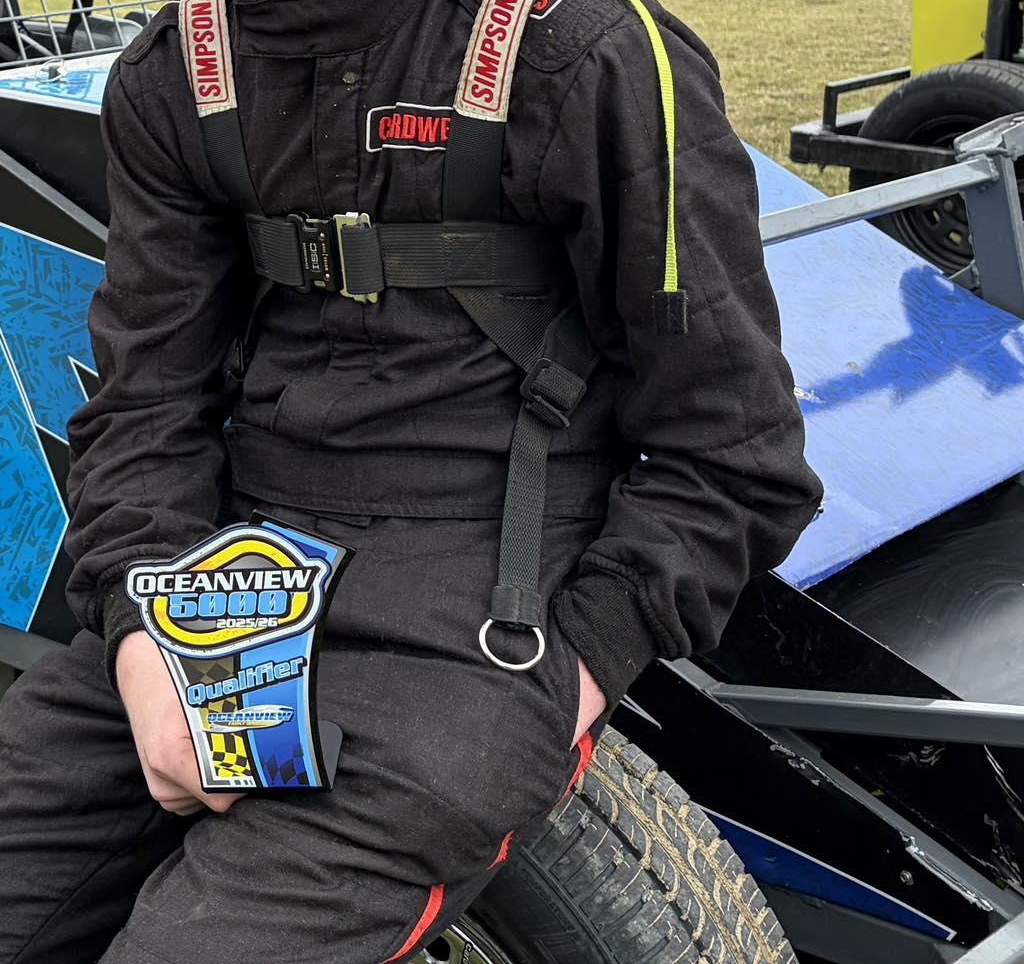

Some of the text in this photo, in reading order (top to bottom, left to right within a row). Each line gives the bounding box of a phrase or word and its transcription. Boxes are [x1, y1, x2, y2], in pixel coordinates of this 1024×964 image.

[191, 1, 222, 99] SIMPSON
[136, 569, 312, 594] OCEANVIEW
[168, 590, 288, 619] 5000
[216, 618, 279, 629] 2025/26
[187, 657, 304, 705] Qualifier
[208, 711, 293, 723] OCEANVIEW
